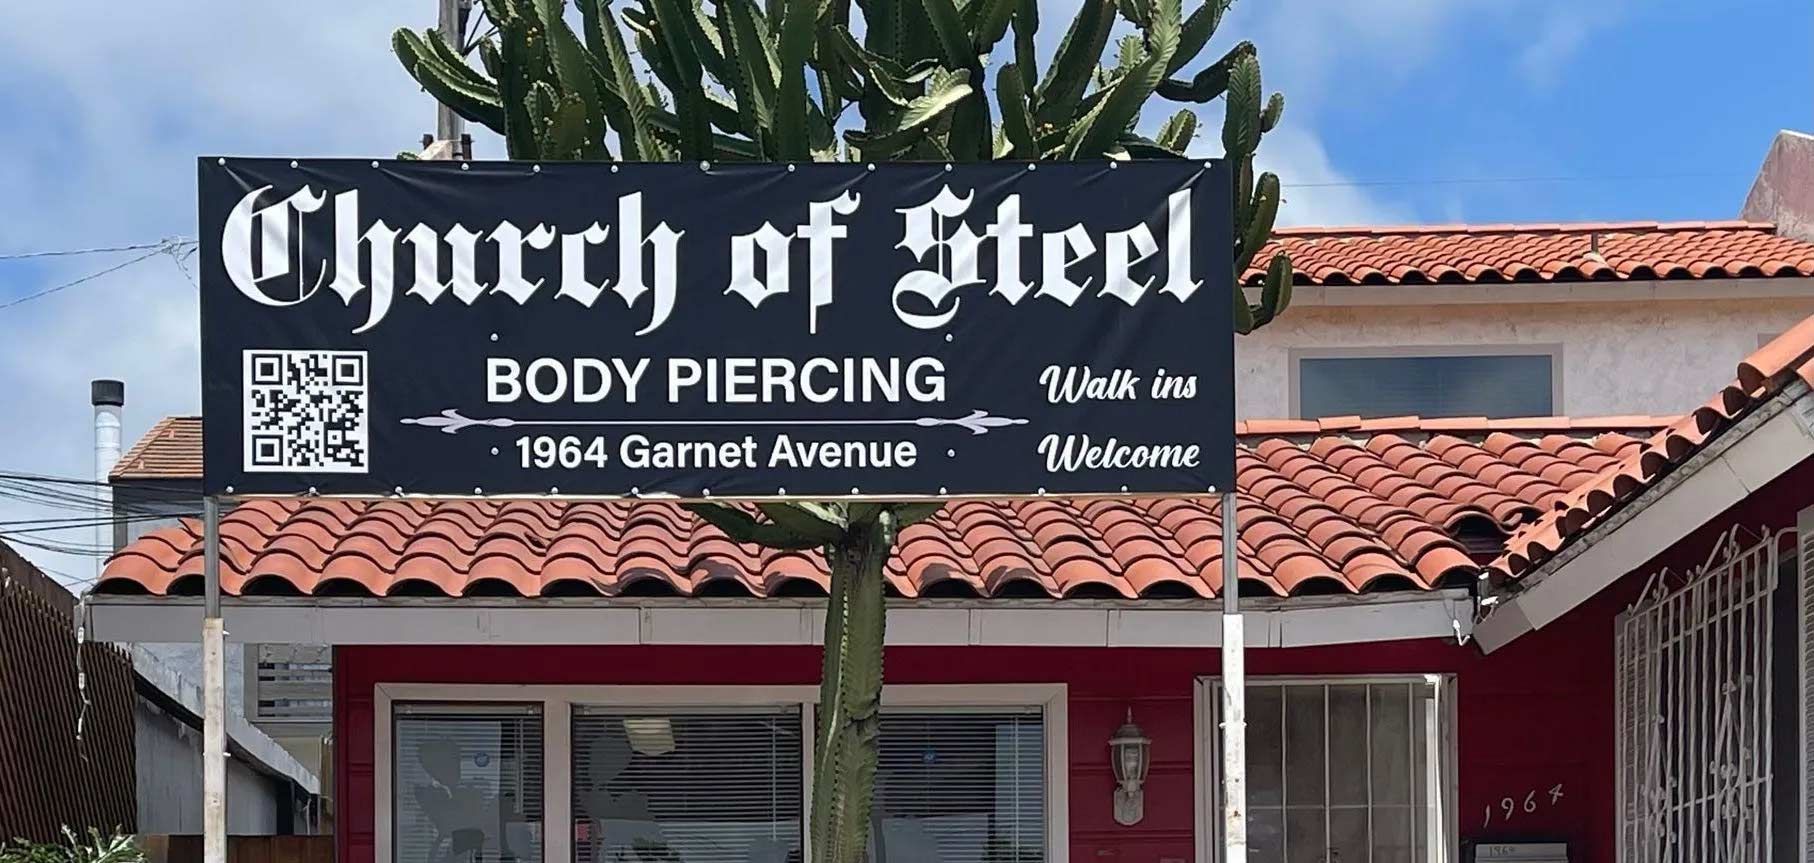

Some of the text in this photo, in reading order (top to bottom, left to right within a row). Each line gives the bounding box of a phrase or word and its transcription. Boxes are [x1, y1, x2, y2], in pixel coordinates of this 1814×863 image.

[221, 183, 1204, 336] Church of Steel
[486, 357, 946, 403] BODY PIERCING
[1038, 364, 1198, 404] Walk ins
[515, 434, 917, 469] 1964 Garnet Avenue
[1037, 433, 1200, 473] Welcome
[1483, 783, 1564, 828] 1964
